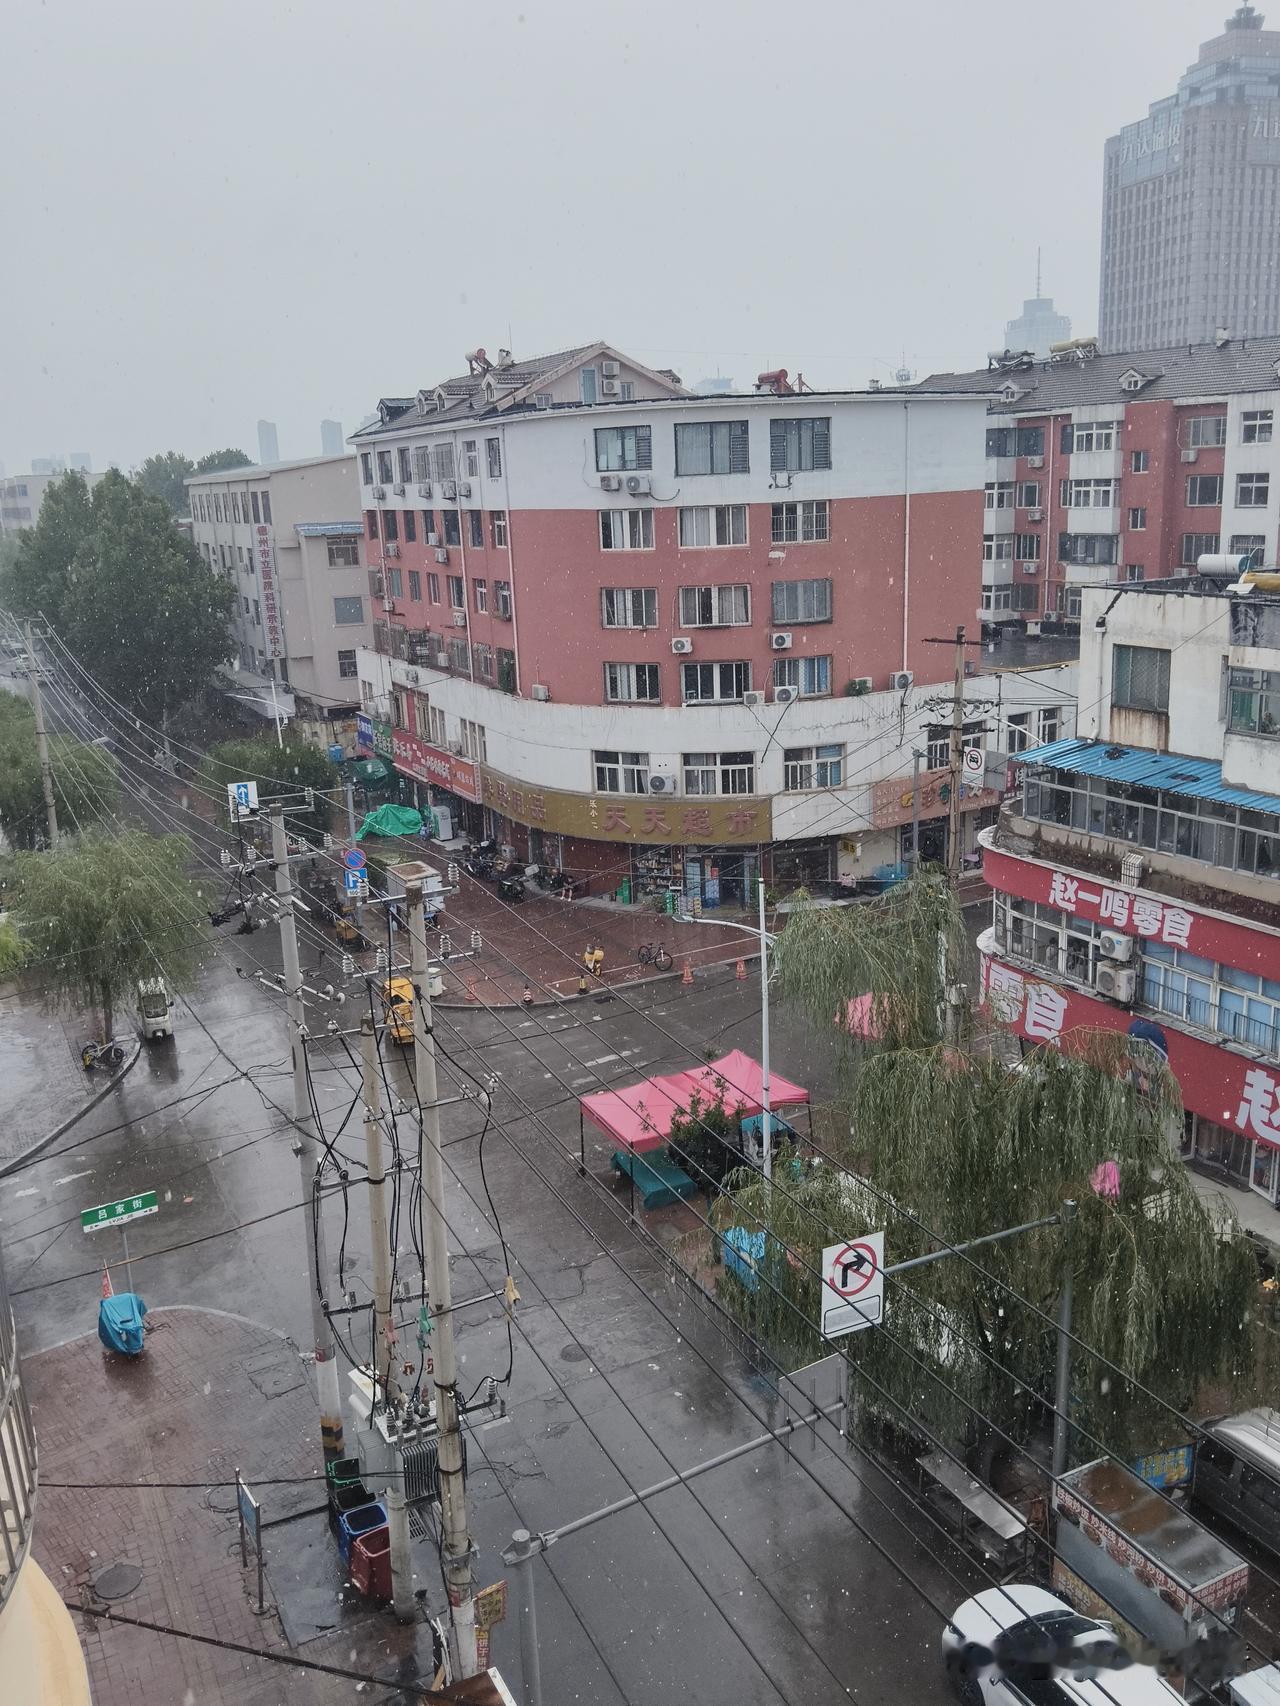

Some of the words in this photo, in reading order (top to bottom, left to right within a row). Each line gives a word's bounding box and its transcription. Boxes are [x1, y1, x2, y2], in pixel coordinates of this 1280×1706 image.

[603, 804, 758, 836] 天天超市
[1049, 871, 1193, 948] 赵一鸣零食
[98, 1199, 142, 1219] 吕家街
